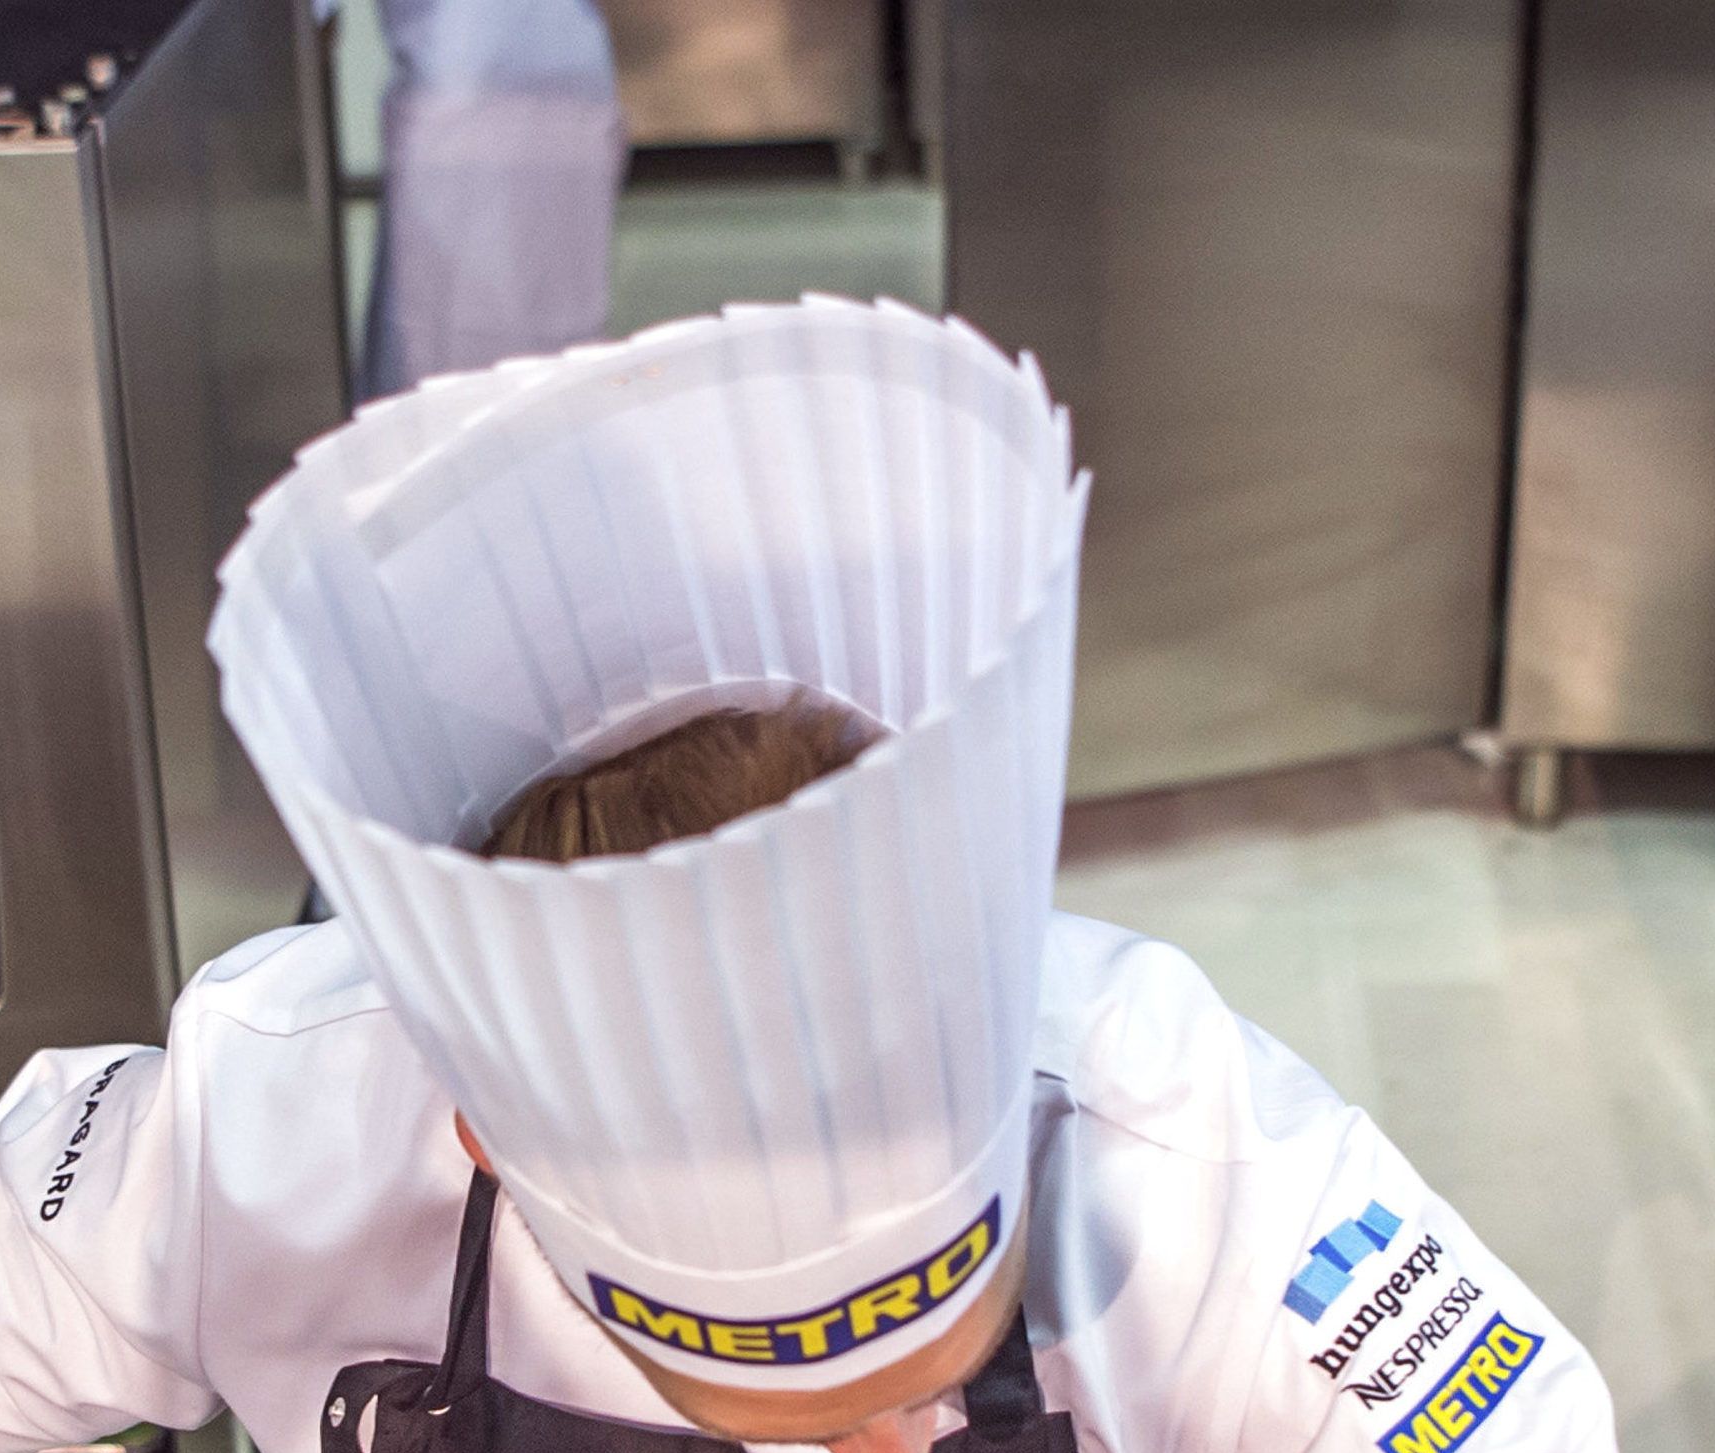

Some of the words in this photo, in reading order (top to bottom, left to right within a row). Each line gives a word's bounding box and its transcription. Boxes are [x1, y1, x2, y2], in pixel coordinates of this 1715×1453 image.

[40, 1056, 129, 1222] BRAGARD
[609, 1220, 990, 1361] METRO
[1308, 1233, 1445, 1379] hungexpo
[1340, 1276, 1485, 1411] NESPRESSO
